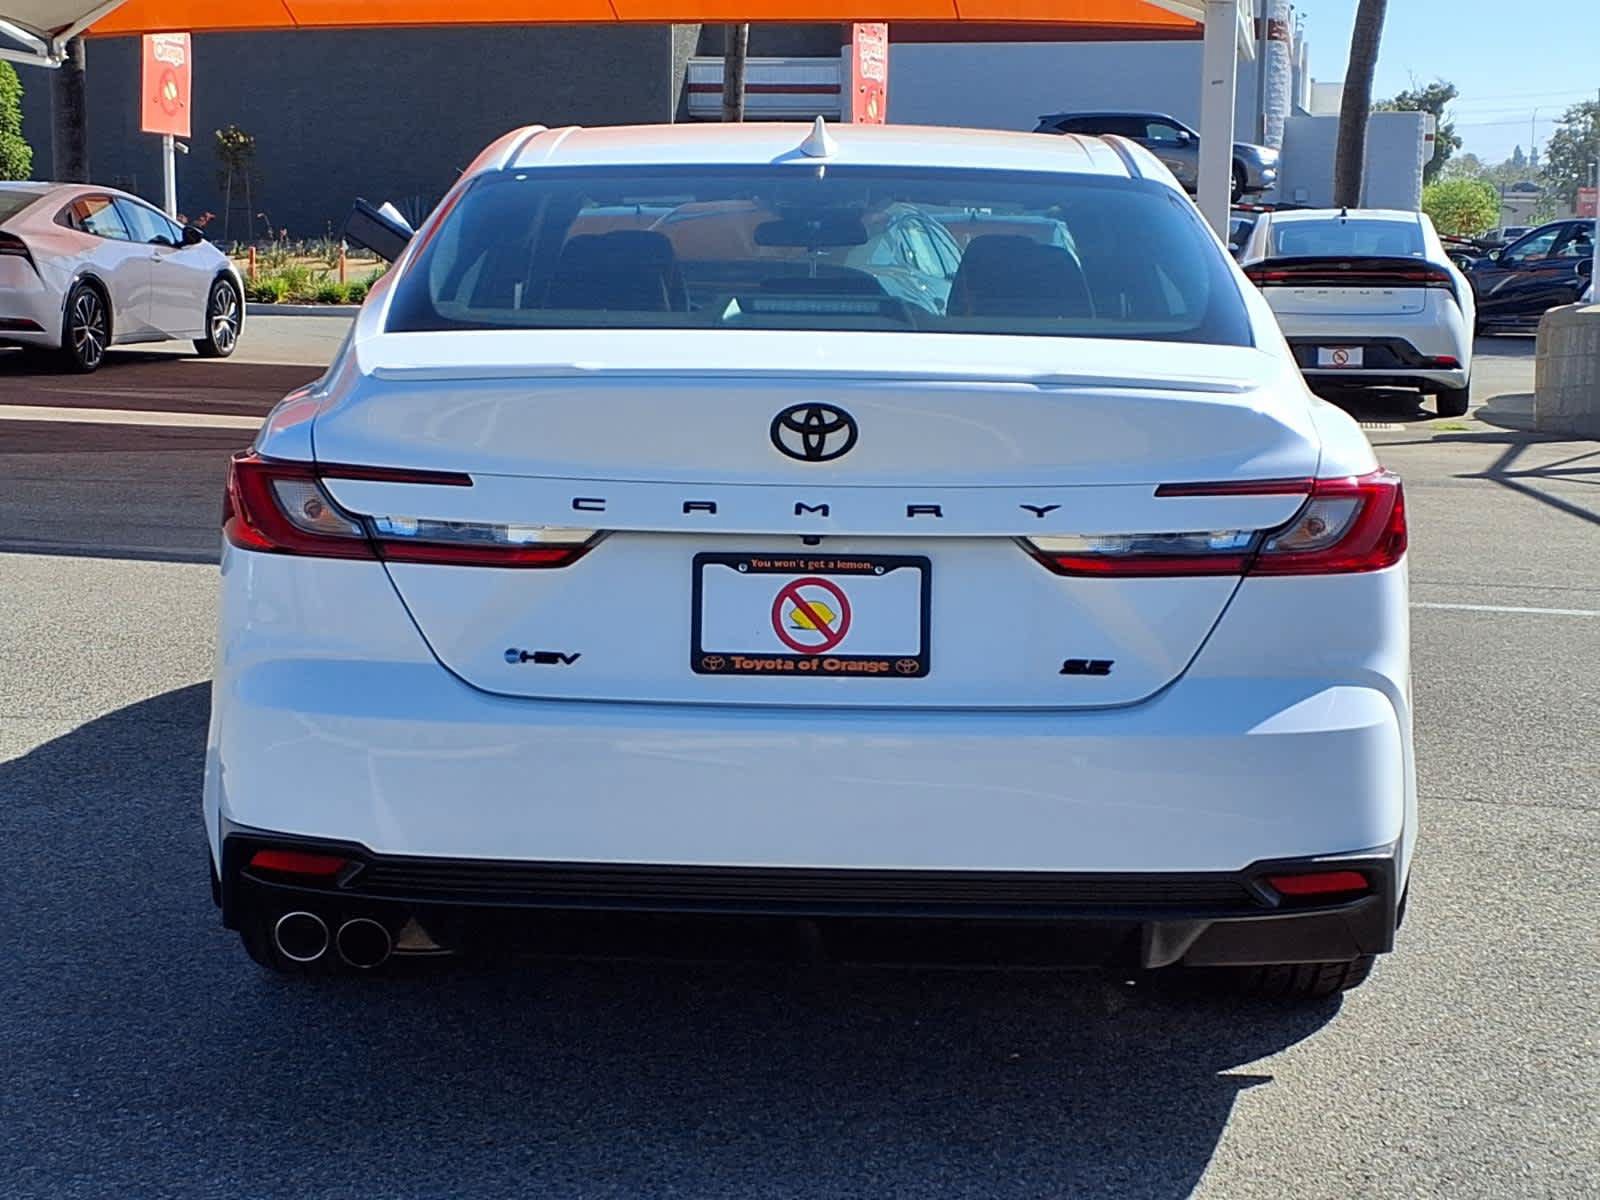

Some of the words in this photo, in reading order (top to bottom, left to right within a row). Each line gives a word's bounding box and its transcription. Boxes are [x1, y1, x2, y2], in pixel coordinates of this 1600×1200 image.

[573, 497, 1061, 518] CAMRY
[751, 559, 771, 568] You
[774, 560, 804, 569] won't
[807, 560, 826, 570] get
[731, 657, 794, 671] Toyota
[798, 658, 820, 671] of
[823, 659, 889, 672] Orange
[1058, 658, 1115, 676] SE
